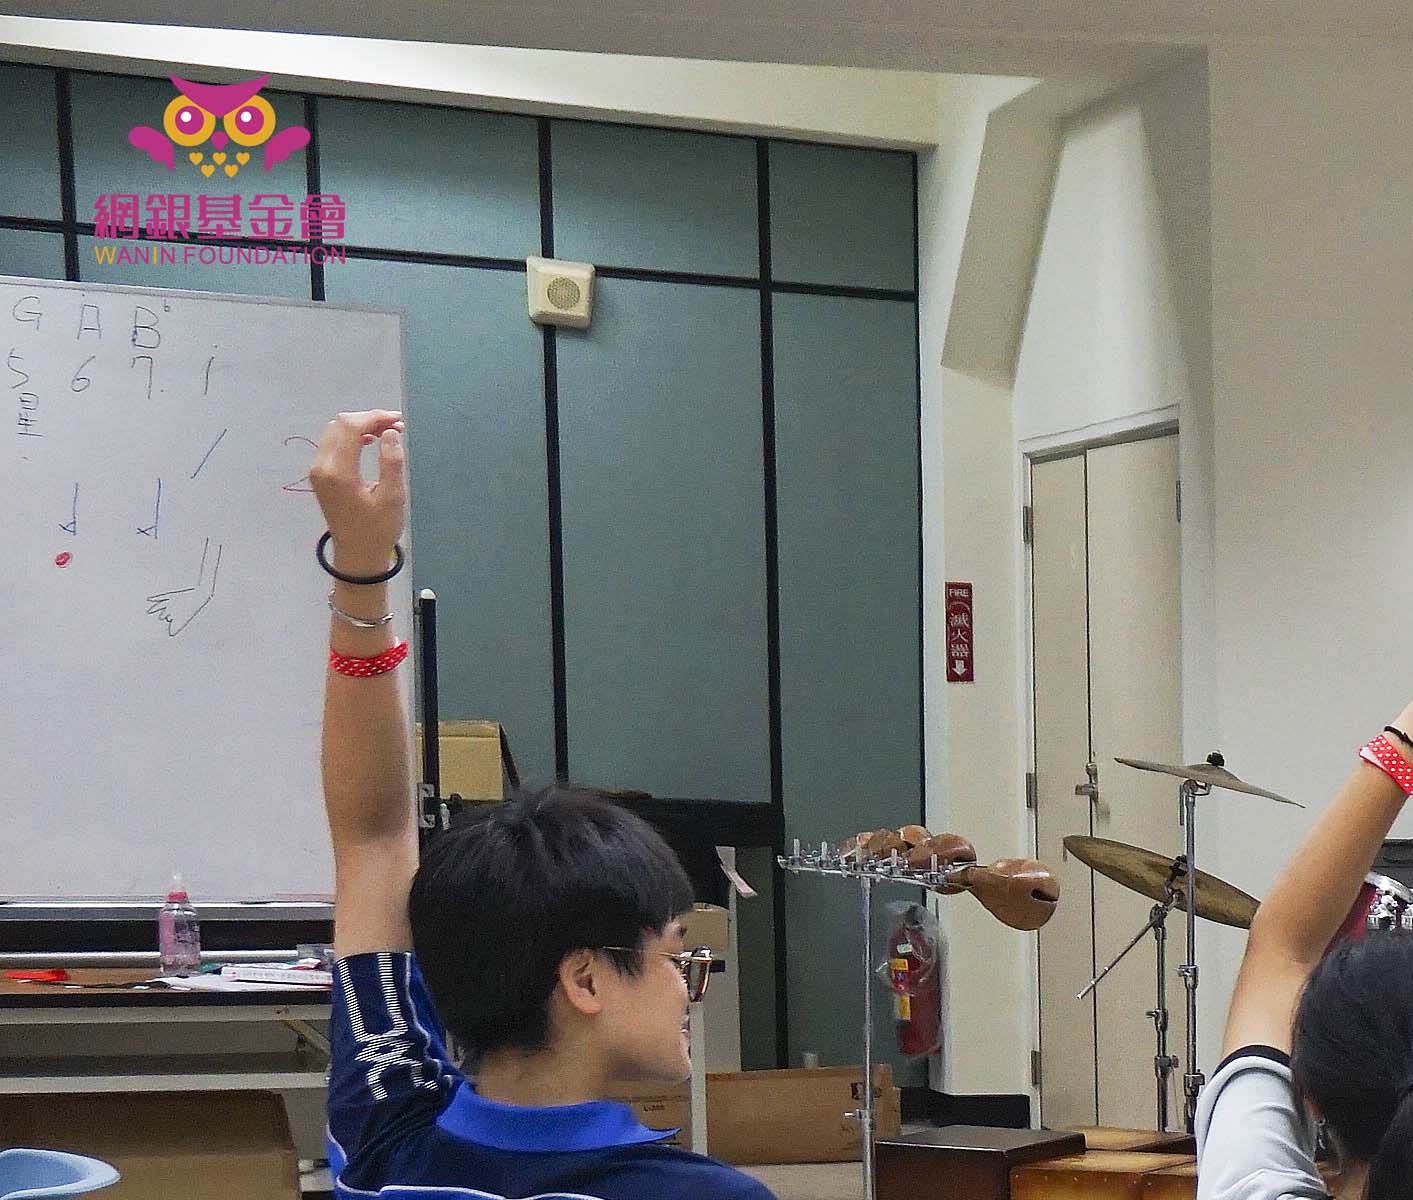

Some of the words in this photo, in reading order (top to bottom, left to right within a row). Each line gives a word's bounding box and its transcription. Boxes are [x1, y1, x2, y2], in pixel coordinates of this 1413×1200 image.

[71, 355, 96, 393] 6
[949, 588, 969, 597] FIRE
[950, 612, 970, 657] 滅火器
